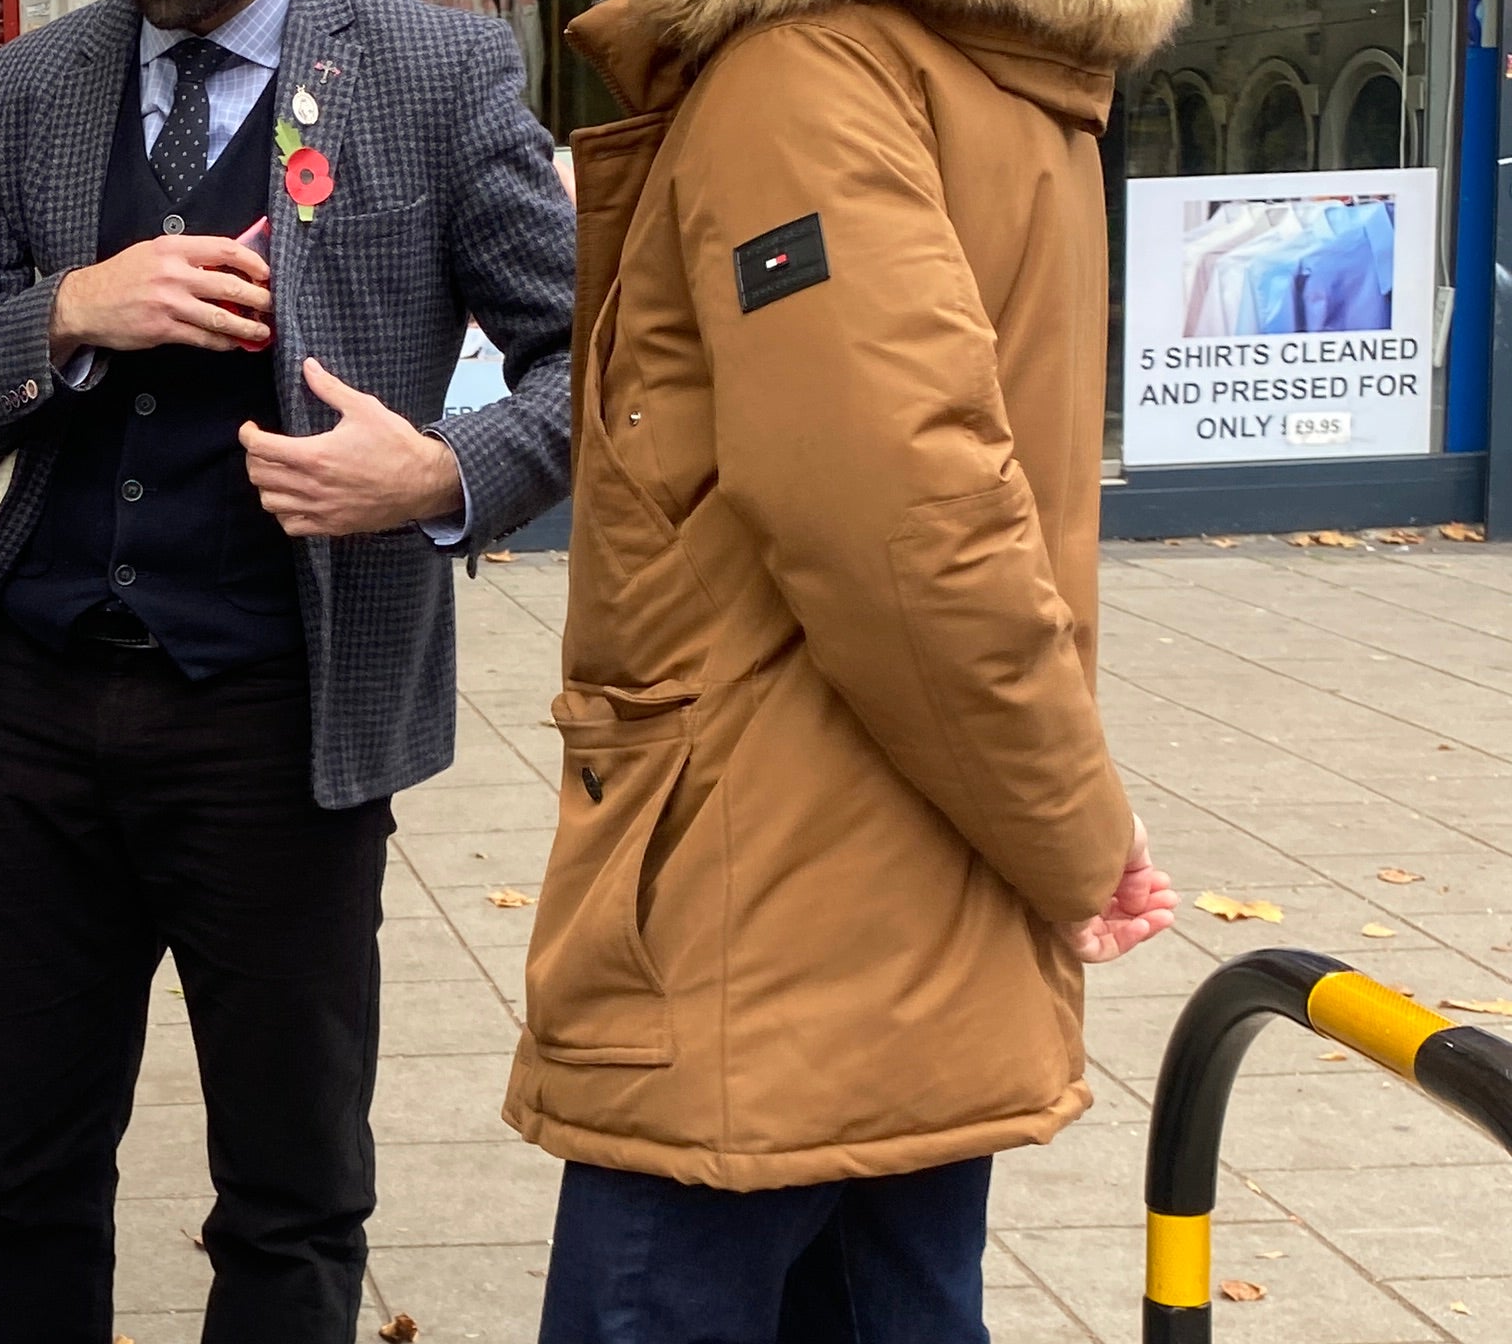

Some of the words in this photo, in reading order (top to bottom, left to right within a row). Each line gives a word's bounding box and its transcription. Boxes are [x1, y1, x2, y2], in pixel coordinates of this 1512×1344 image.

[1141, 350, 1156, 370] 5
[1165, 343, 1270, 369] SHIRTS
[1280, 337, 1419, 365] CLEANED
[1140, 382, 1201, 406] AND
[1213, 376, 1349, 403] PRESSED
[1360, 374, 1419, 397] FOR
[1196, 416, 1272, 439] ONLY
